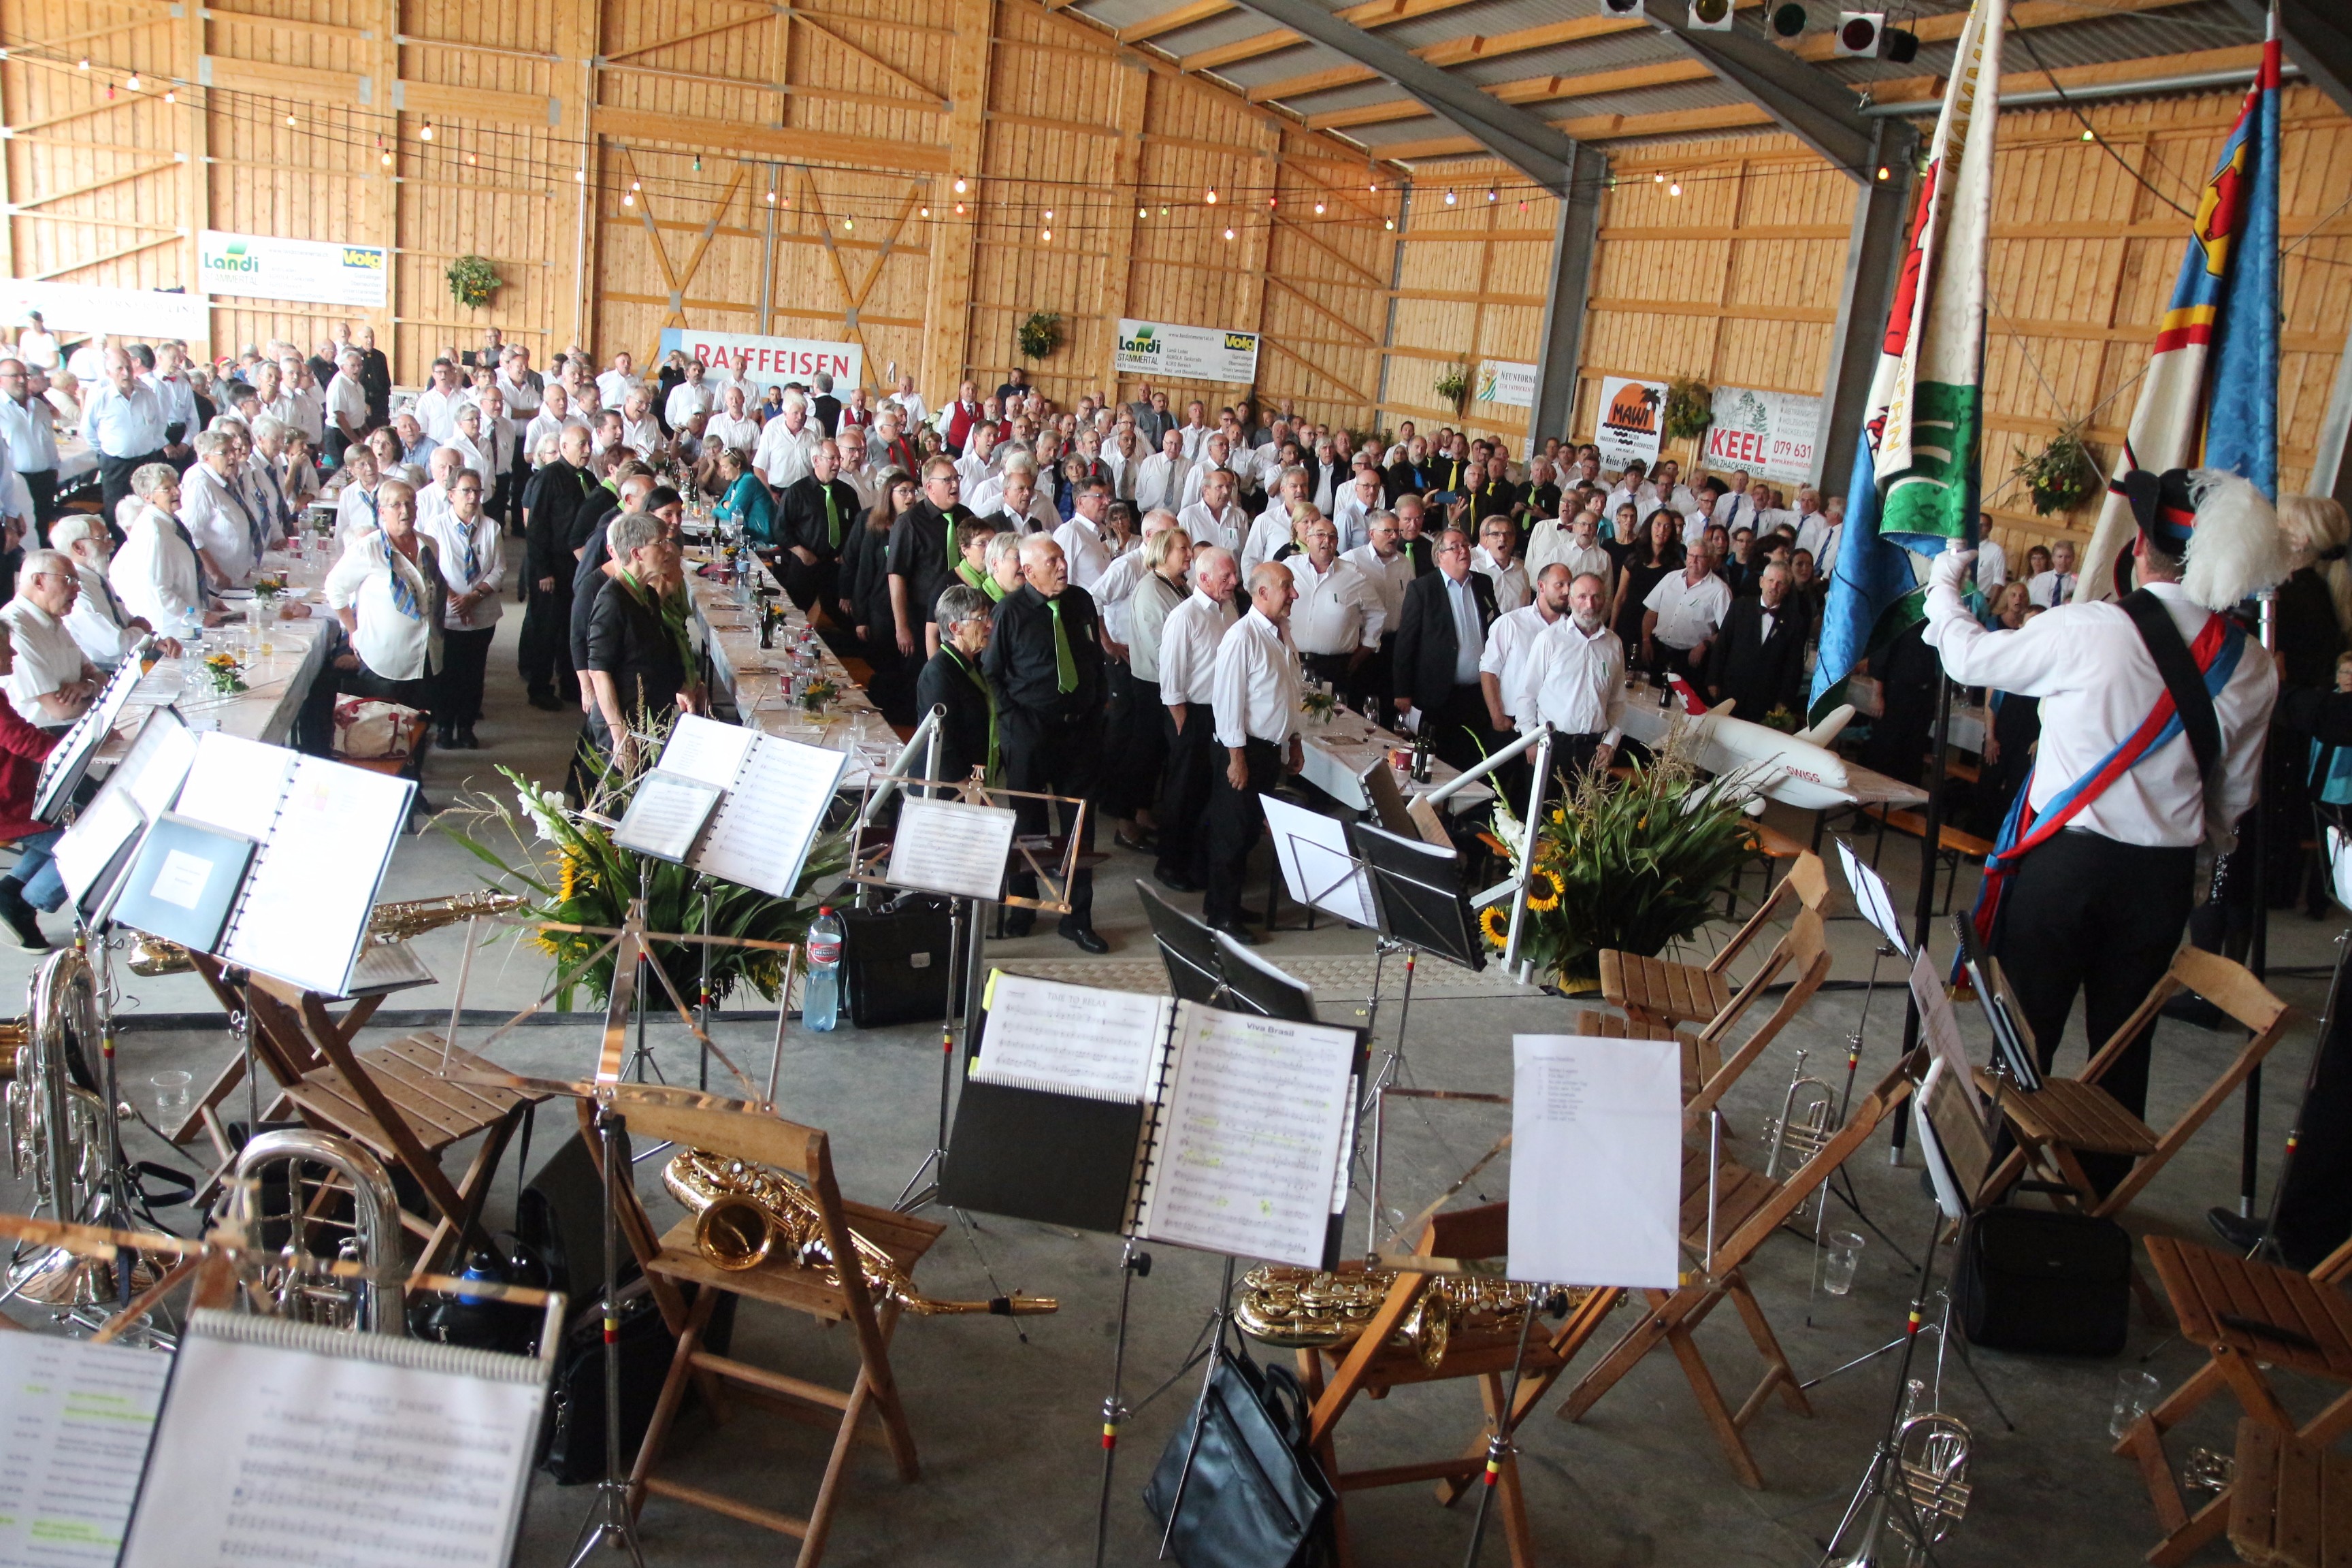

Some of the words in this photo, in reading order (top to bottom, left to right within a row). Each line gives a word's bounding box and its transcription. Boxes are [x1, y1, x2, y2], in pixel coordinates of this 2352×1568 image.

[204, 252, 259, 273] Landi
[343, 249, 382, 270] Volg
[1119, 336, 1161, 355] Landi
[1225, 334, 1254, 352] Volg
[1117, 353, 1158, 365] STAMMERTAL
[1710, 427, 1767, 464] KEEL
[1774, 440, 1791, 456] 079
[1794, 443, 1812, 459] 631
[1708, 457, 1765, 476] HOLZHACKSERVICE
[1786, 765, 1821, 783] SWISS
[1047, 992, 1065, 1002] TIME
[1068, 995, 1079, 1003] TO
[1082, 998, 1107, 1007] RELAX
[1247, 1022, 1265, 1032] Viva
[1267, 1026, 1294, 1037] Brasil
